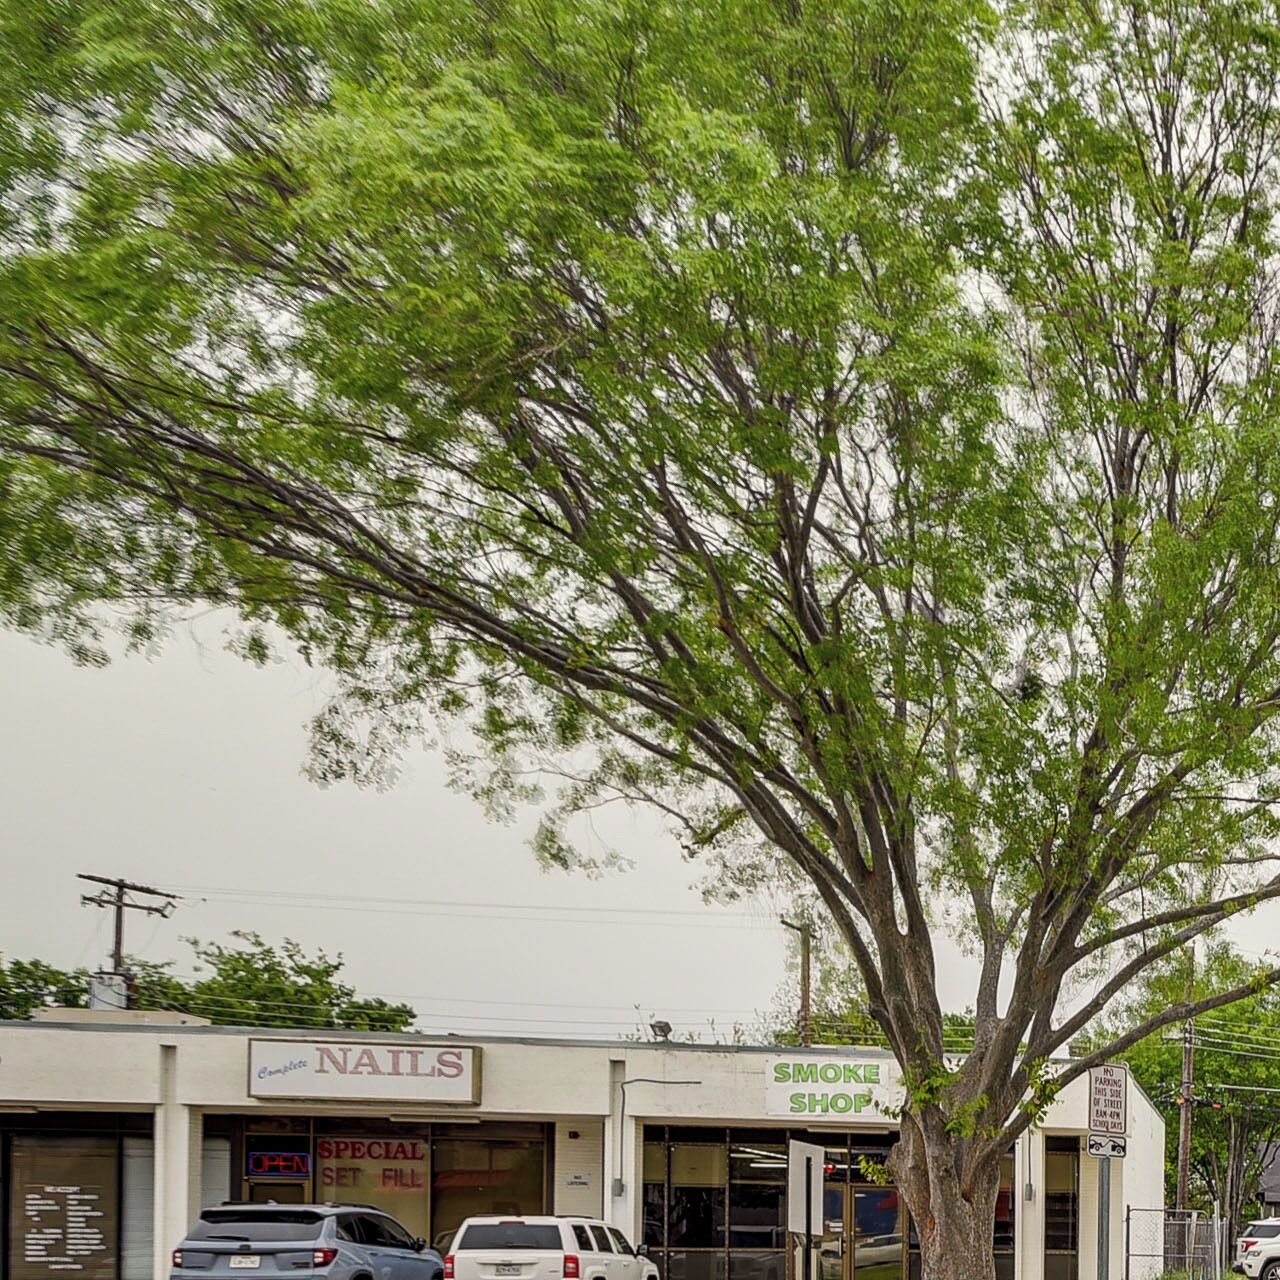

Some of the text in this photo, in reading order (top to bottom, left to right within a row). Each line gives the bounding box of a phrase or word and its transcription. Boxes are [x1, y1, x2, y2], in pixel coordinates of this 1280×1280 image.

[257, 1047, 464, 1080] Complete NAILS
[1104, 1068, 1113, 1076] NO
[774, 1063, 880, 1084] SMOKE
[1095, 1077, 1122, 1088] PARKING
[1095, 1087, 1122, 1099] THIS SIDE
[789, 1093, 873, 1113] SHOP
[1094, 1098, 1122, 1109] OF STREET
[1110, 1121, 1122, 1130] DAYS
[317, 1141, 426, 1160] SPECIAL
[250, 1154, 310, 1173] OPEN
[322, 1167, 423, 1187] SET FILL
